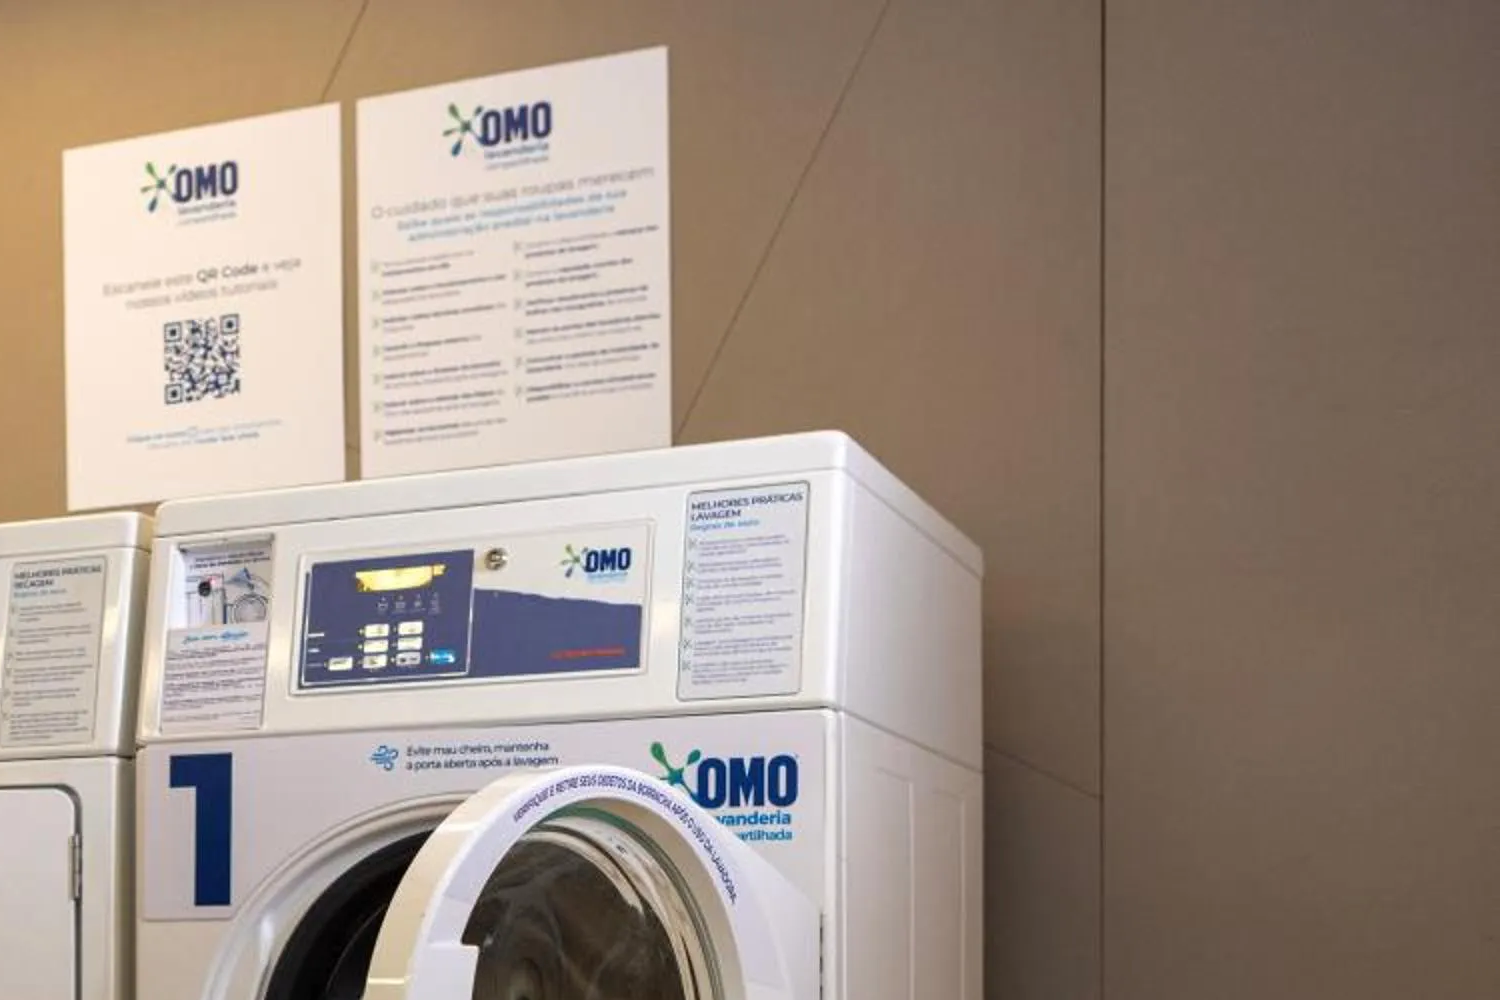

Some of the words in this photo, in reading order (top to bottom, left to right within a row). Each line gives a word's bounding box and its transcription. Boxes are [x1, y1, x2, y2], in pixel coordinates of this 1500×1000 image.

[479, 102, 551, 147] OMO
[173, 160, 237, 203] OMO
[197, 267, 218, 283] QR
[221, 263, 258, 278] Code
[584, 547, 631, 573] OMO
[406, 745, 430, 757] Evite
[434, 746, 457, 755] mau
[494, 742, 549, 753] mantenha
[415, 760, 441, 772] porta
[443, 758, 476, 769] aberta
[478, 756, 503, 769] após
[514, 755, 559, 768] lavagem
[697, 755, 798, 809] OMO
[170, 753, 232, 906] 1
[716, 811, 791, 826] vanderia
